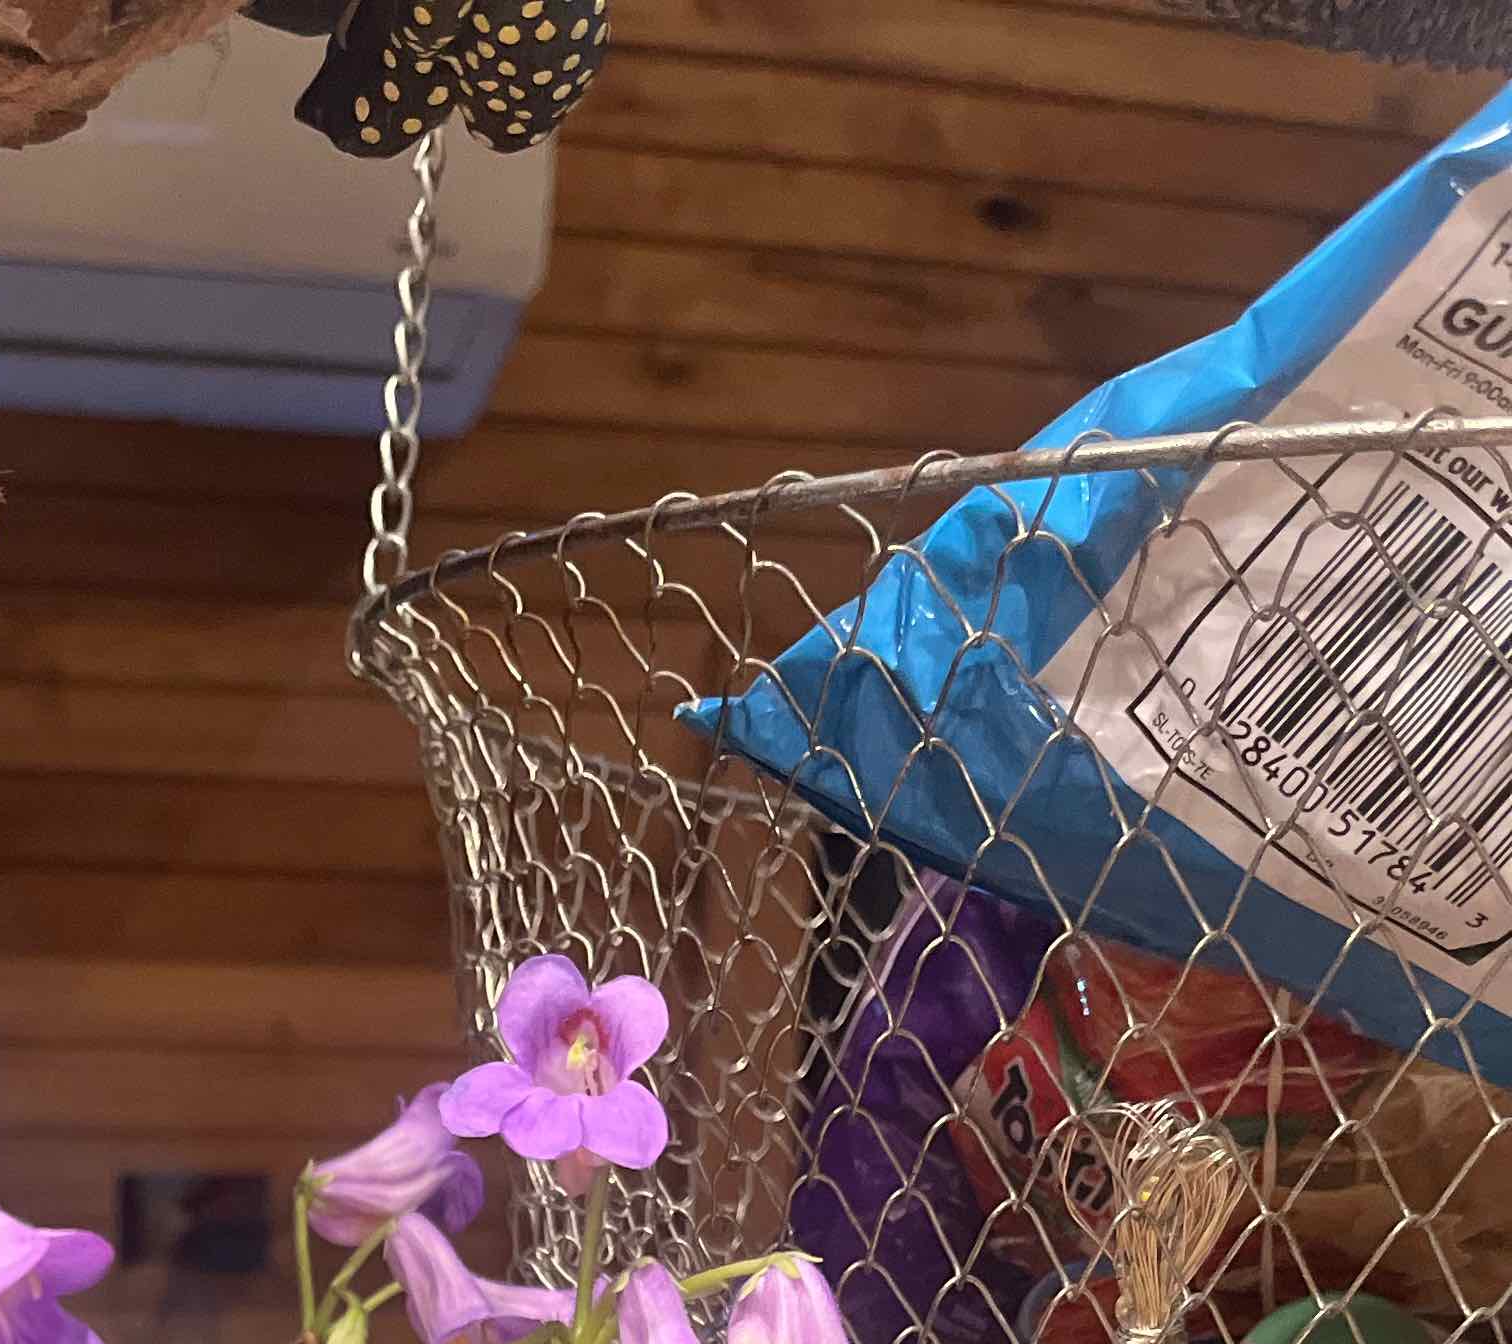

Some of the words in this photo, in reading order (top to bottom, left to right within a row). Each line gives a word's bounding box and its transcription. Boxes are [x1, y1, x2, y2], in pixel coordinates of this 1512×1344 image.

[1395, 334, 1465, 380] Mon-Fri
[1448, 456, 1494, 492] our
[1327, 808, 1433, 894] 51784
[1465, 912, 1489, 928] 3
